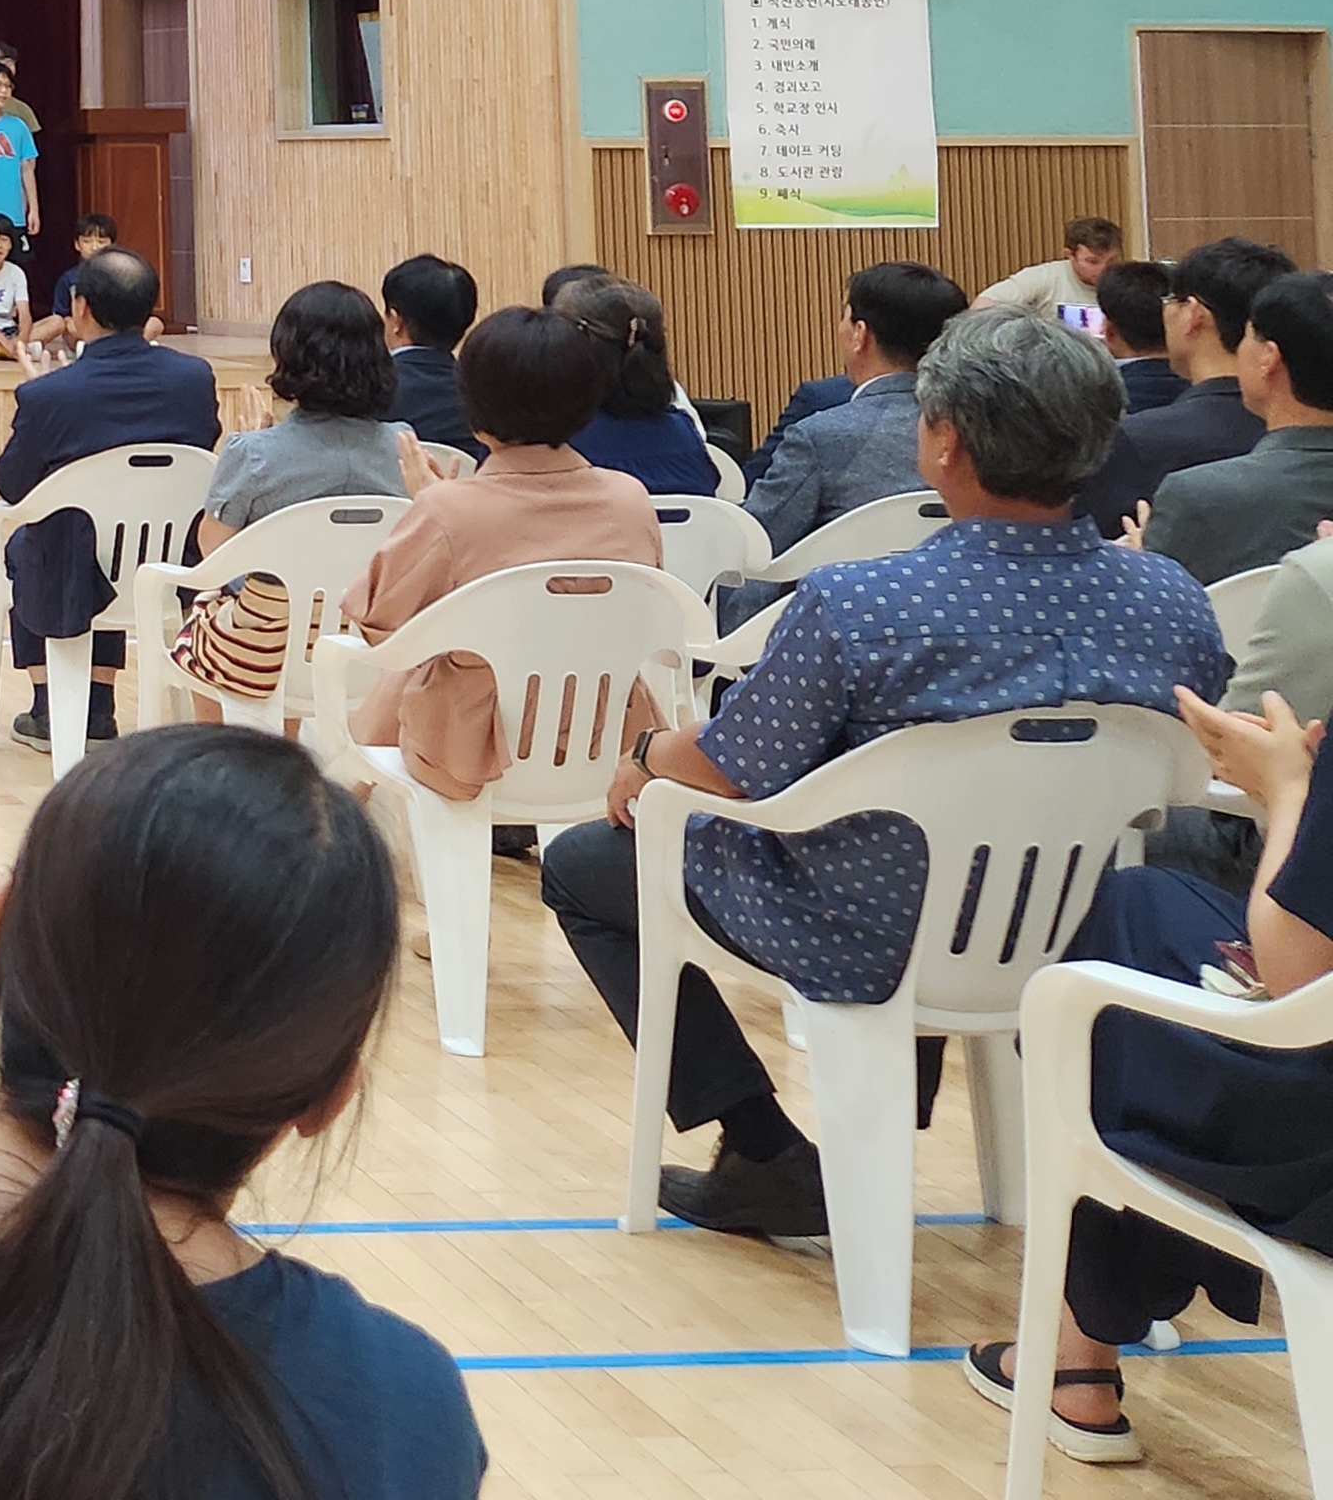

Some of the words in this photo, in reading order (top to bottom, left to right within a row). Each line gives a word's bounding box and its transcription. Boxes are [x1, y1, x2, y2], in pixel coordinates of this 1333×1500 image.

[751, 17, 761, 29] 1.
[766, 17, 791, 30] 개식
[752, 38, 764, 50] 2.
[768, 38, 816, 51] 국민의례
[754, 59, 766, 71] 3.
[771, 59, 819, 72] 내빈소개
[755, 81, 768, 93] 4.
[774, 80, 822, 94] 경과보고
[756, 102, 769, 114] 5.
[773, 102, 810, 115] 학교장
[814, 102, 839, 115] 인사
[758, 123, 771, 135] 6.
[775, 123, 799, 136] 축사
[760, 145, 771, 157] 7.
[776, 144, 813, 157] 테이프
[818, 144, 842, 157] 커팅
[759, 166, 772, 178] 8.
[777, 166, 814, 179] 도서관
[819, 165, 843, 179] 관람
[759, 187, 772, 199] 9.
[777, 187, 801, 200] 폐식
